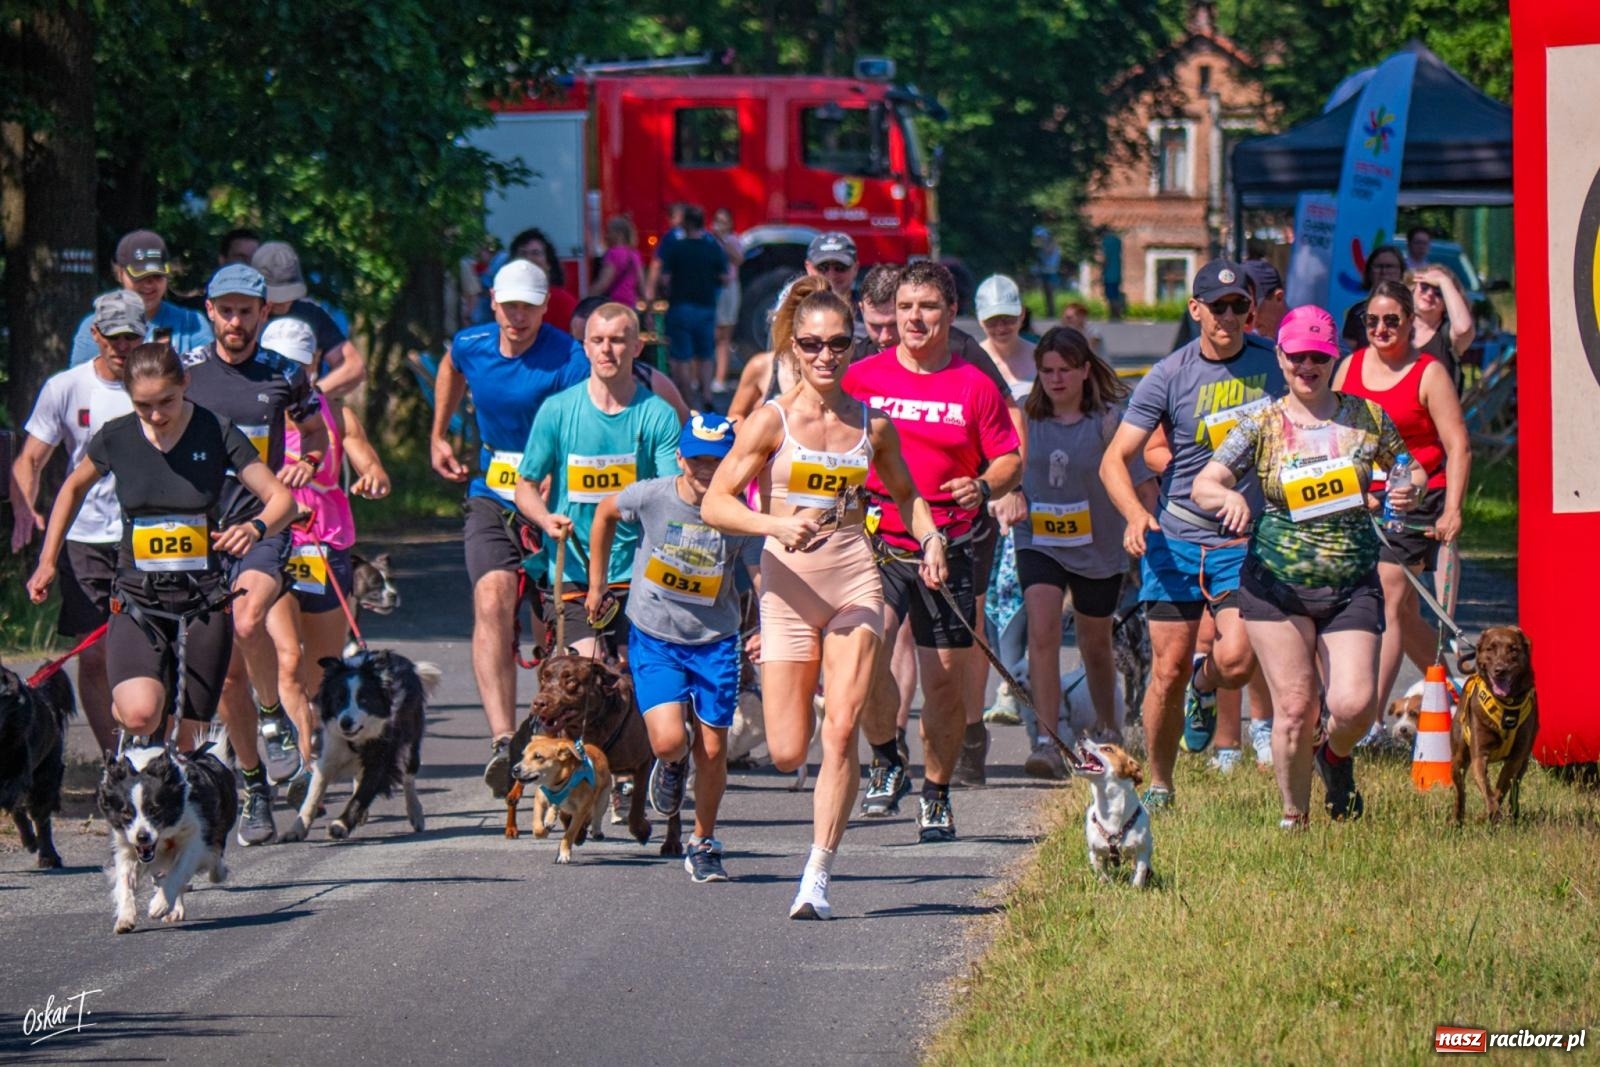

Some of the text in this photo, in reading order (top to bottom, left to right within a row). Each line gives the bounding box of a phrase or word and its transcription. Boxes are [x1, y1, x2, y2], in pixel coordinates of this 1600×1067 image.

[499, 471, 516, 486] 01
[583, 473, 622, 488] 001
[807, 473, 847, 491] 021
[1302, 478, 1344, 502] 020
[1044, 520, 1078, 534] 023
[149, 536, 193, 555] 026
[284, 563, 311, 578] 29
[662, 572, 702, 594] 031
